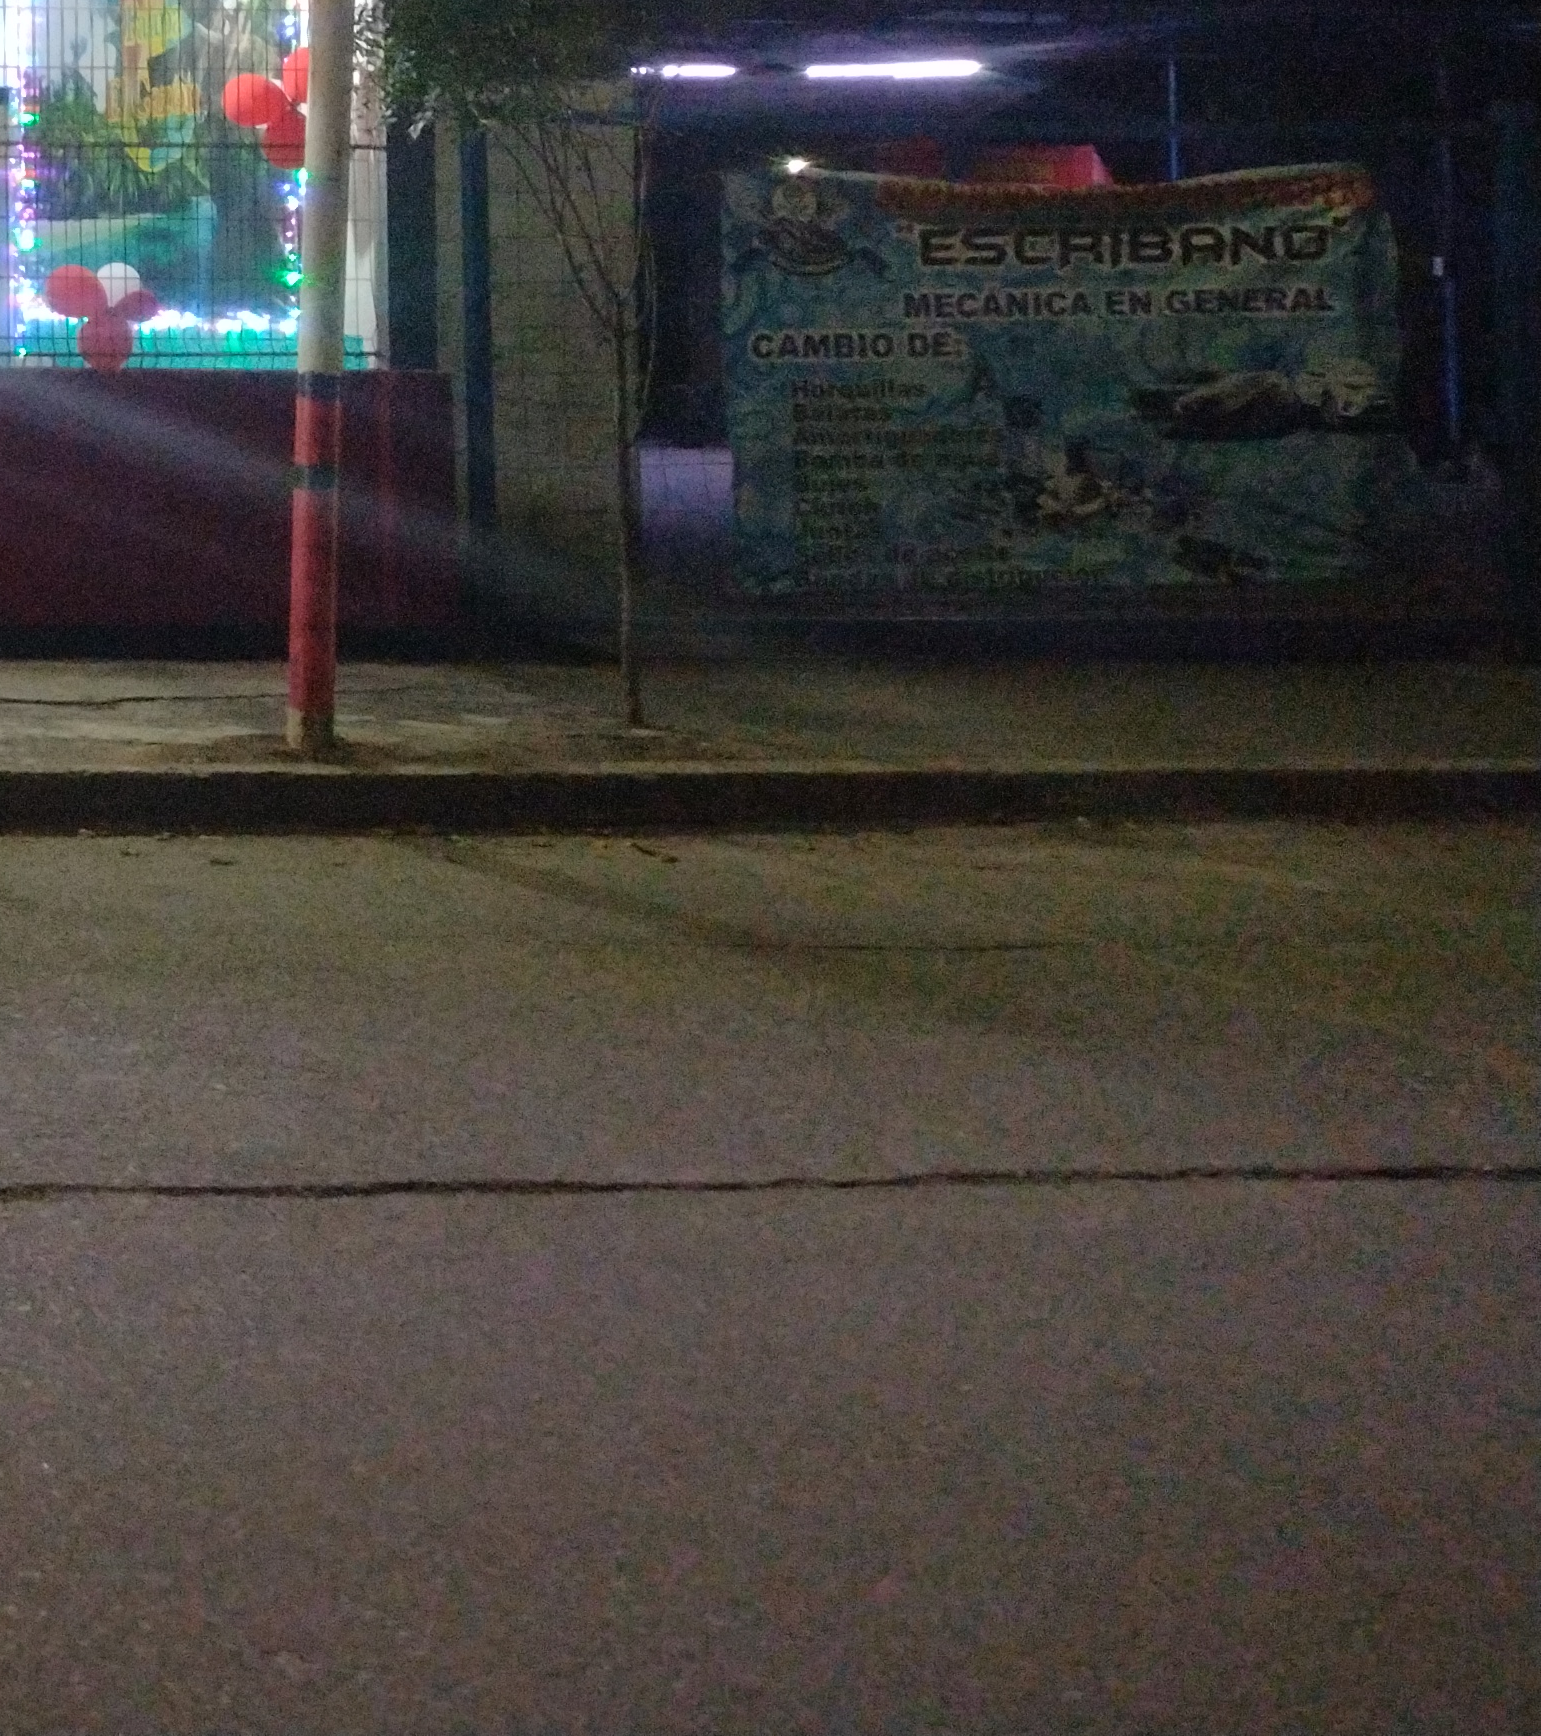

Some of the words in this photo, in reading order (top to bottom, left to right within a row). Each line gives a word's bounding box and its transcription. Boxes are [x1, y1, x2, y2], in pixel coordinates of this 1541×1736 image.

[1105, 287, 1152, 316] EN
[1164, 286, 1335, 316] GENERAL
[750, 330, 894, 360] CAMBIO
